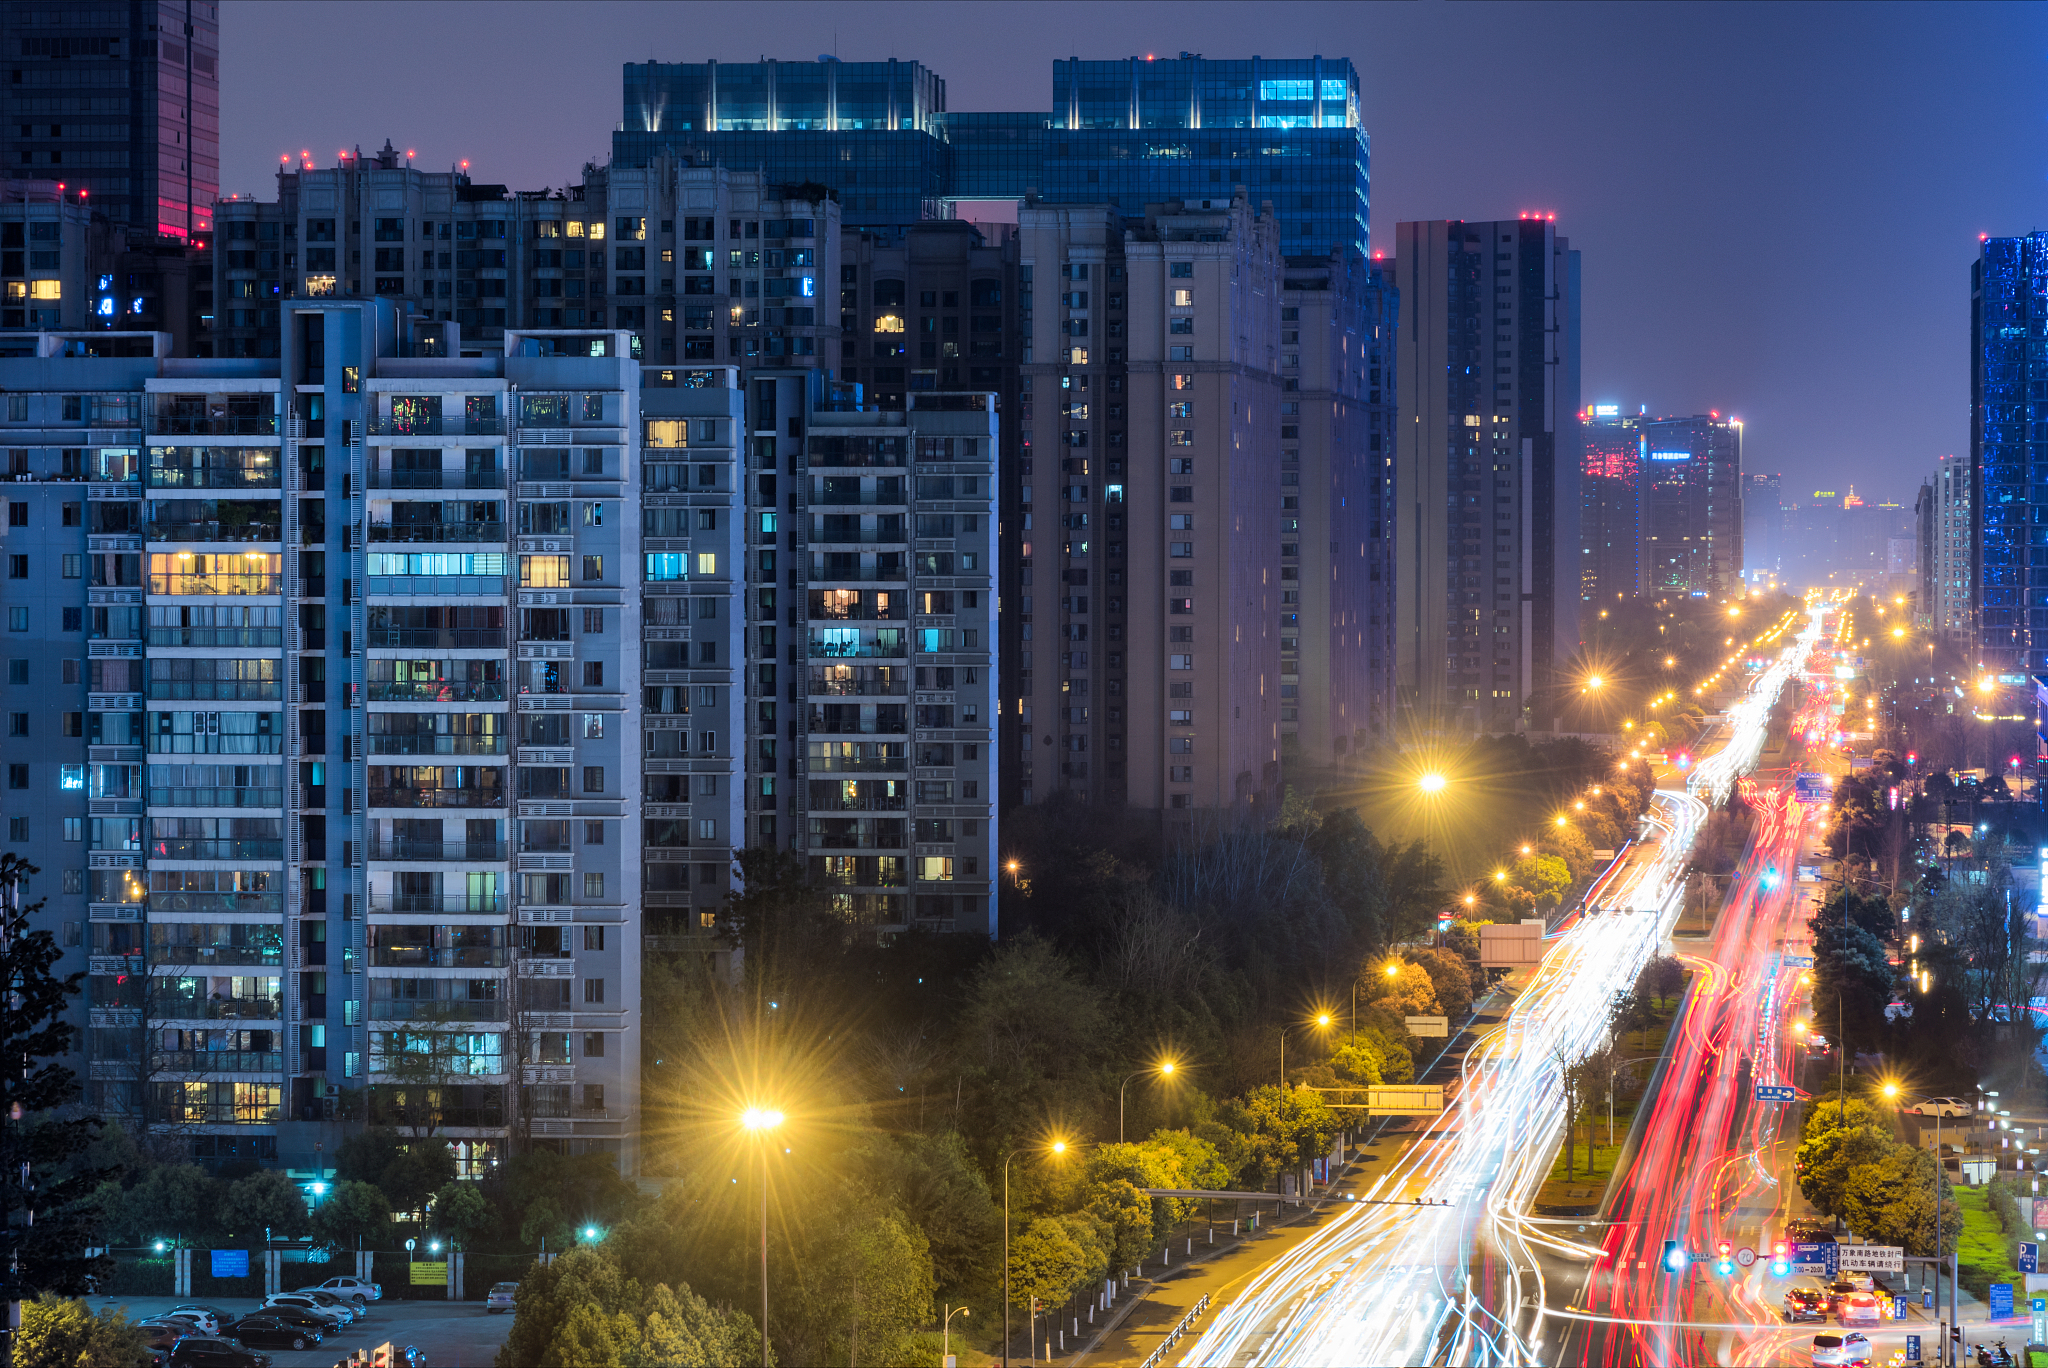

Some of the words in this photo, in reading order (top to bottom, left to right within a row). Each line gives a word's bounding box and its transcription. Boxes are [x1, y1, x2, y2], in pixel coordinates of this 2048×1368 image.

[2019, 1244, 2027, 1260] P
[1741, 1253, 1752, 1262] 70
[1841, 1259, 1901, 1268] 机动车辆请绕行
[2036, 1301, 2042, 1309] P
[1908, 1336, 1916, 1360] 禁止停车
